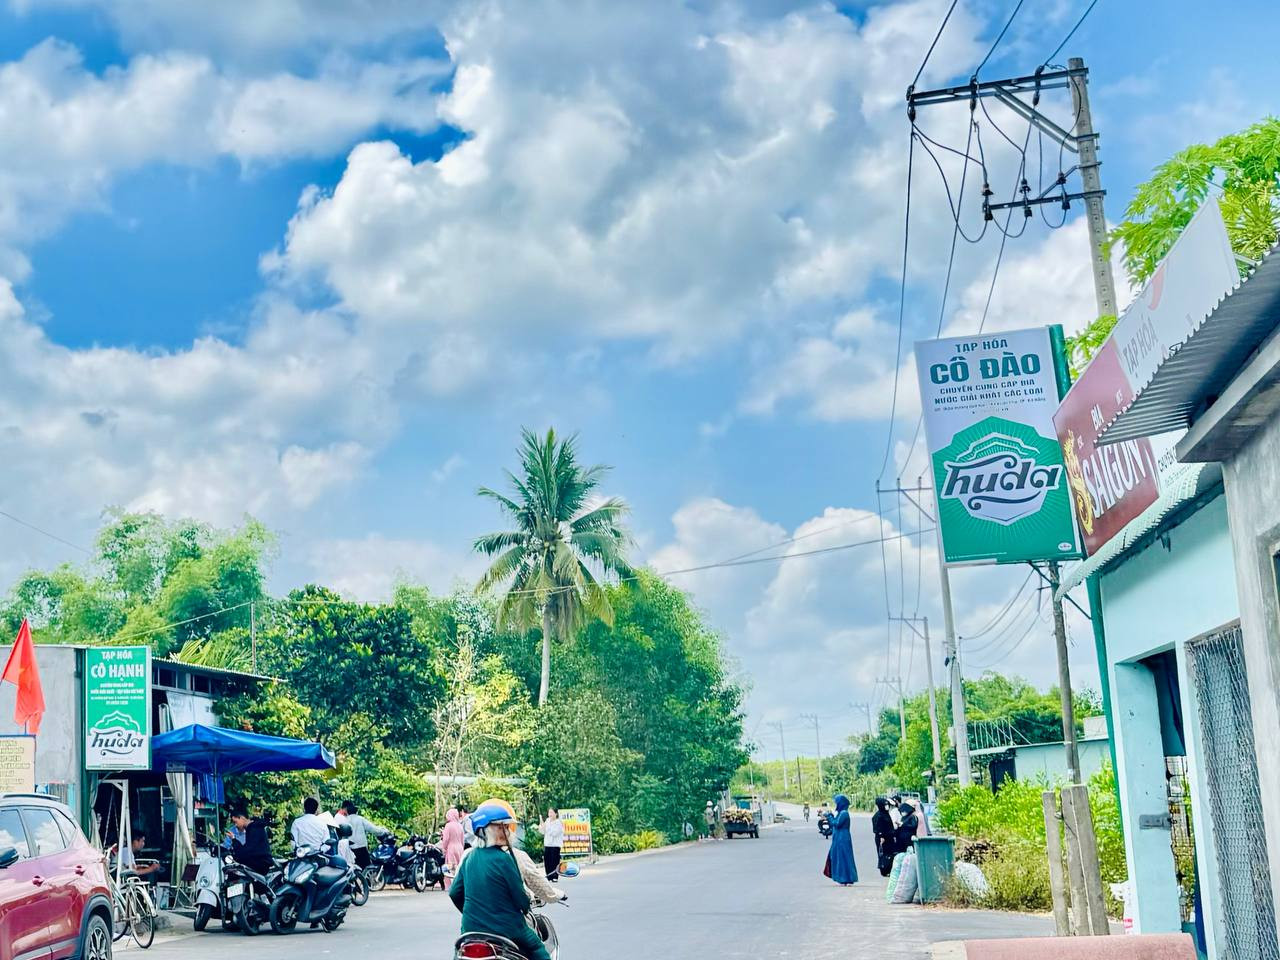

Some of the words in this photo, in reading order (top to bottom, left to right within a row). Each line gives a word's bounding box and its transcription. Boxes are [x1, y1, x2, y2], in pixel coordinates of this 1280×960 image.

[955, 342, 978, 354] TẠP
[982, 338, 1009, 350] HÓA
[929, 355, 970, 385] CÔ
[979, 351, 1041, 379] ĐÀO
[940, 384, 973, 394] CHUYÊN
[975, 383, 998, 392] CUNG
[979, 389, 1001, 400] KHÁT
[1004, 387, 1022, 398] CÁC
[944, 454, 1060, 496] huda
[1082, 438, 1147, 519] SAIGON
[101, 650, 116, 661] TẠP
[116, 649, 133, 660] HÓA
[90, 662, 107, 678] CÔ
[108, 663, 145, 682] HẠNH
[91, 730, 144, 748] huda
